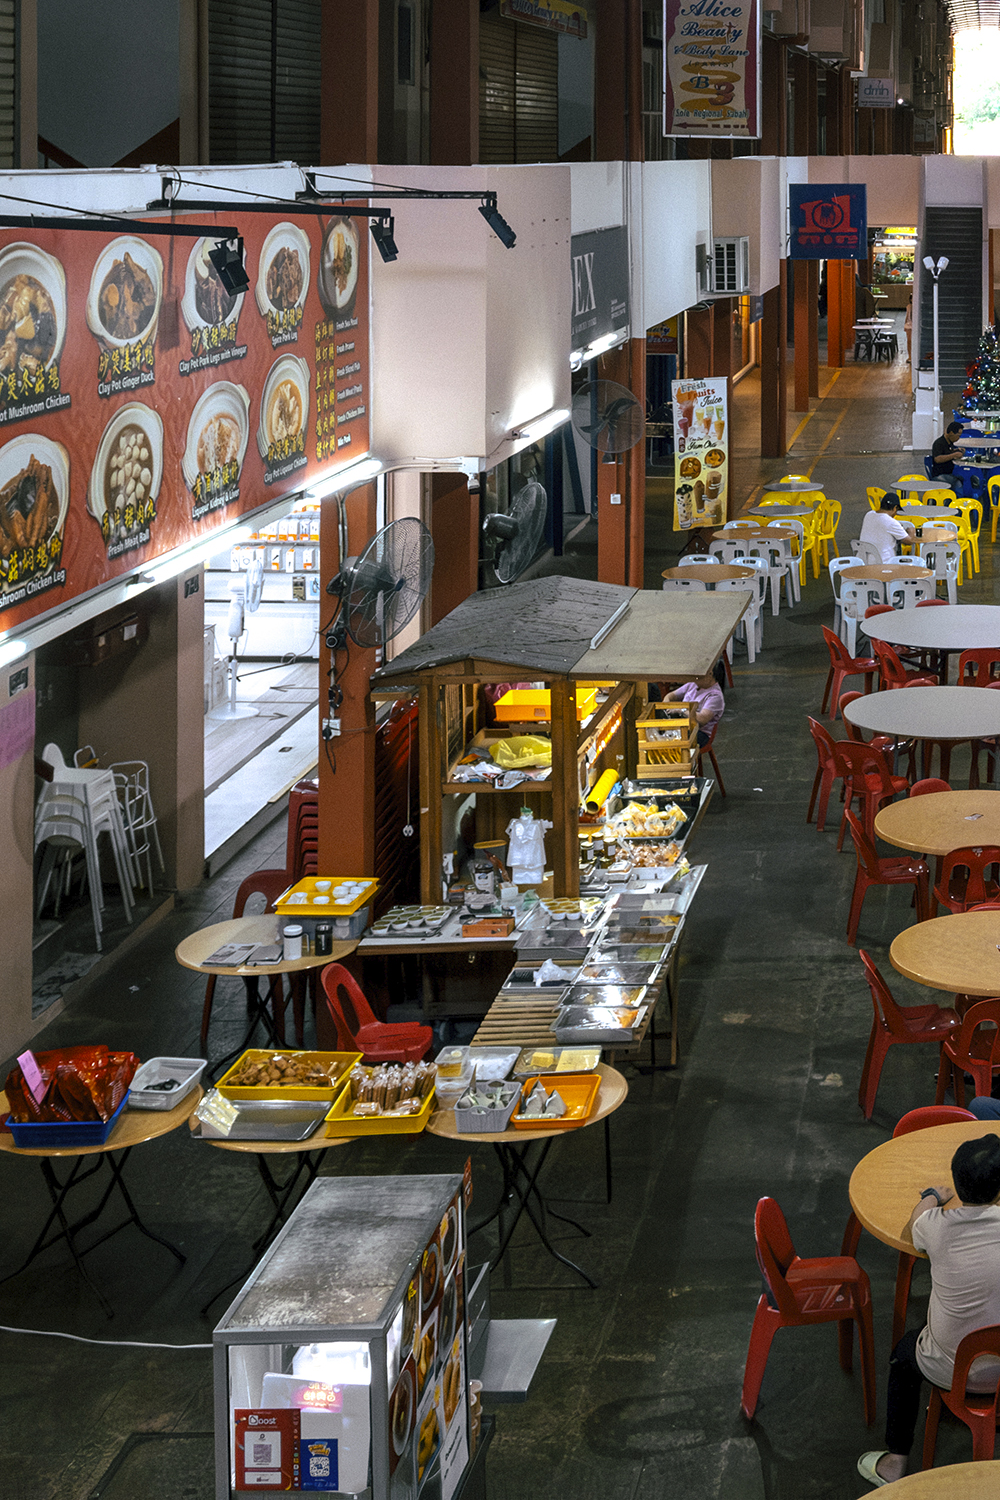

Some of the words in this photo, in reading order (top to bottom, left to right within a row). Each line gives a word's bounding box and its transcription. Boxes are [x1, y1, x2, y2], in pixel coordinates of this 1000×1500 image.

[681, 21, 743, 43] Beauty
[683, 44, 717, 59] Body
[719, 45, 750, 57] Lane
[693, 107, 723, 120] Regional
[179, 360, 190, 373] Clay
[220, 350, 231, 361] with
[231, 344, 247, 359] Vinegar
[0, 366, 60, 401] 煲冬菇鸡
[98, 382, 111, 396] Clay
[112, 380, 122, 391] Pot
[122, 375, 141, 390] Ginger
[141, 370, 155, 384] Duck
[681, 381, 707, 393] Fresh
[8, 400, 45, 419] Mushroom
[45, 393, 71, 411] Chicken
[700, 394, 723, 408] Juice
[209, 495, 225, 510] Kidney
[108, 541, 123, 557] Fresh
[124, 534, 139, 549] Meat
[139, 527, 150, 543] Ball
[0, 586, 26, 607] shroom
[26, 575, 52, 595] Chicken
[53, 568, 66, 583] Leg
